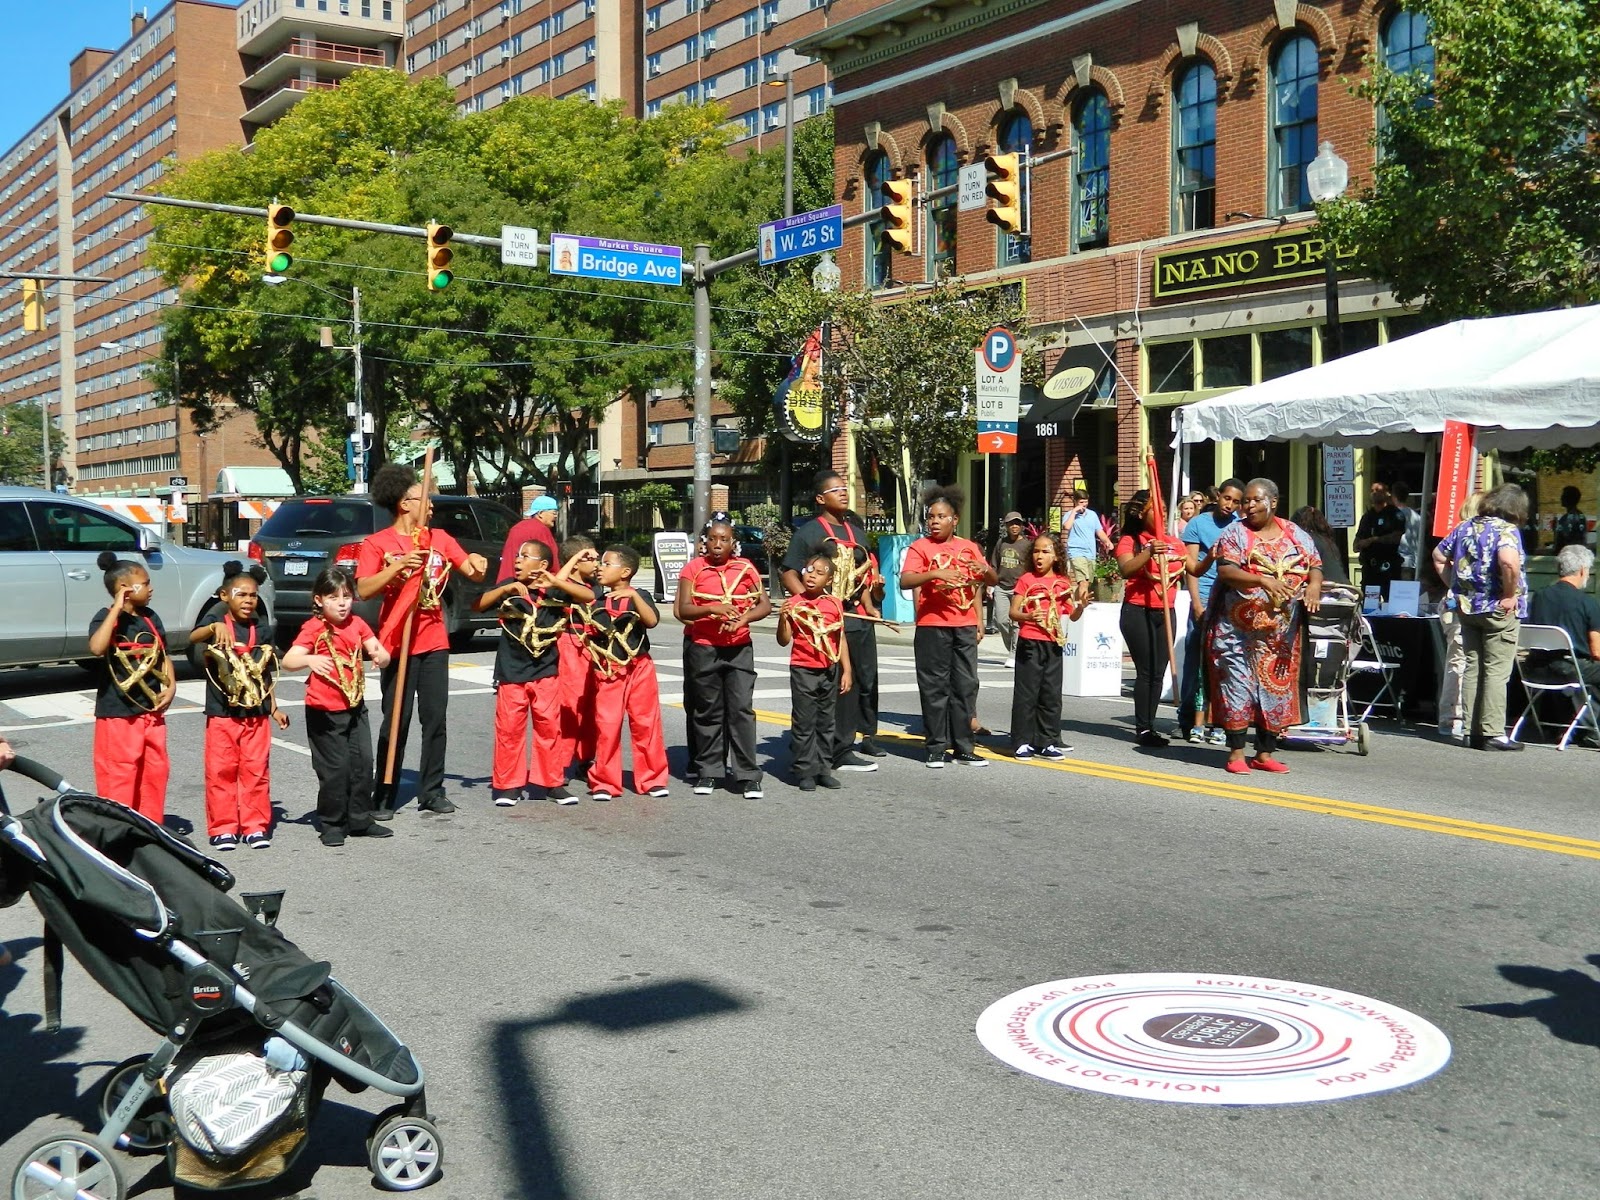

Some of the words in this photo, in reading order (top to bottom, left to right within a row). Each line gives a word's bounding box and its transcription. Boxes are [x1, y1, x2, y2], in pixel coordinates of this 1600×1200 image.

[967, 170, 977, 180] NO
[964, 181, 980, 192] TURN
[961, 194, 970, 203] ON
[971, 190, 984, 201] RED
[785, 216, 807, 227] Market
[808, 210, 829, 221] Square
[514, 232, 526, 241] NO
[780, 233, 798, 252] W.
[801, 227, 817, 248] 25
[820, 224, 835, 243] St
[510, 240, 530, 250] TURN
[598, 239, 630, 251] Market
[633, 243, 664, 255] Square
[505, 250, 517, 258] ON
[518, 251, 534, 260] RED
[1162, 250, 1259, 286] NANO
[1272, 238, 1359, 269] BRE
[582, 253, 639, 276] Bridge
[643, 260, 677, 279] Ave
[991, 335, 1009, 363] P
[981, 375, 997, 384] LOT
[998, 376, 1004, 385] A
[1052, 375, 1086, 391] VISION
[981, 383, 998, 393] Market
[998, 385, 1010, 393] Only
[981, 400, 996, 409] LOT
[997, 401, 1003, 409] B
[980, 409, 996, 418] Public
[1035, 422, 1058, 437] 1861
[1326, 451, 1352, 459] PARKING
[1451, 433, 1463, 482] LUTHERAN
[1332, 465, 1347, 473] TIME
[1334, 486, 1346, 494] NO
[1446, 484, 1458, 531] HOSPITAL
[664, 561, 684, 569] FOOD
[1061, 643, 1078, 657] ASH
[1360, 639, 1404, 659] Cinic
[193, 986, 220, 994] Britax
[1072, 982, 1116, 992] POP
[1196, 979, 1333, 1001] LOCATION
[1042, 990, 1068, 1001] UP
[1006, 1001, 1066, 1066] PERFORMANCE
[1171, 1015, 1214, 1040] cleveland
[1187, 1018, 1235, 1043] PUBLIC
[1208, 1021, 1253, 1046] theatre
[1335, 999, 1417, 1062] PERFORMANCE
[1368, 1061, 1398, 1074] UP
[1066, 1065, 1221, 1093] LOCATION
[1316, 1072, 1367, 1086] POP
